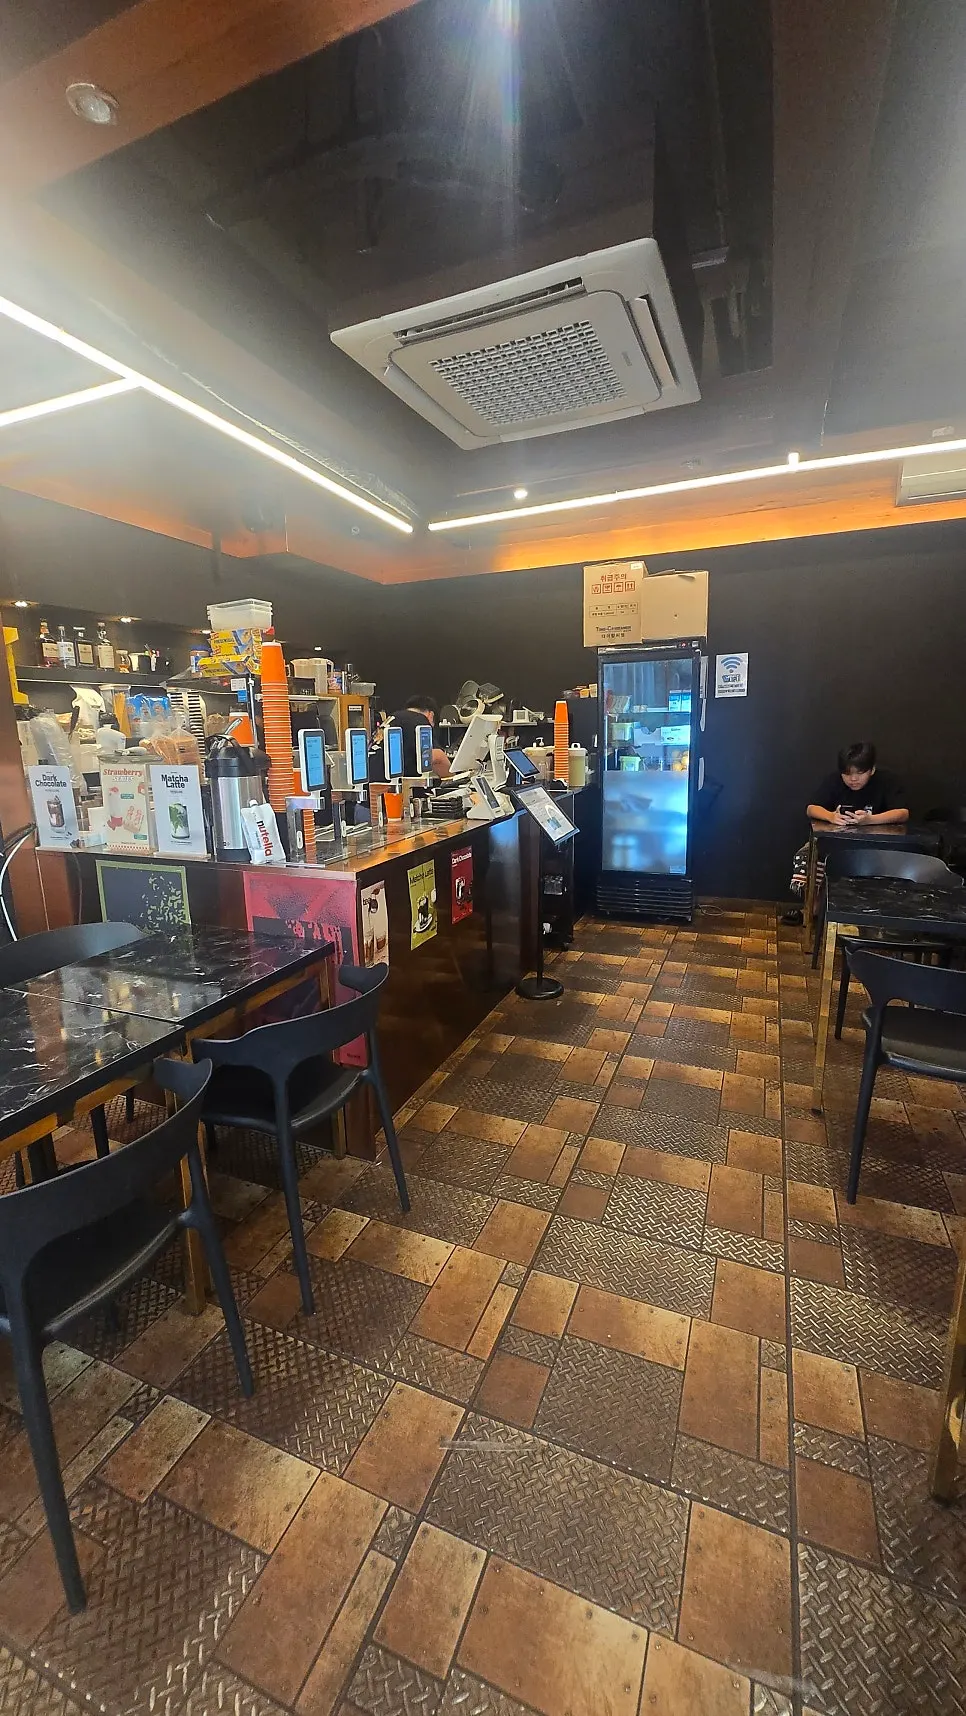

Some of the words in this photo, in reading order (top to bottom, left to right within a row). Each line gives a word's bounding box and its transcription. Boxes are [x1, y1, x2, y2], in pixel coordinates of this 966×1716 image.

[601, 573, 627, 582] 취급주의
[103, 768, 142, 777] Strawberry
[161, 774, 189, 782] Matcha
[165, 780, 186, 788] Latte
[256, 820, 274, 857] nutella
